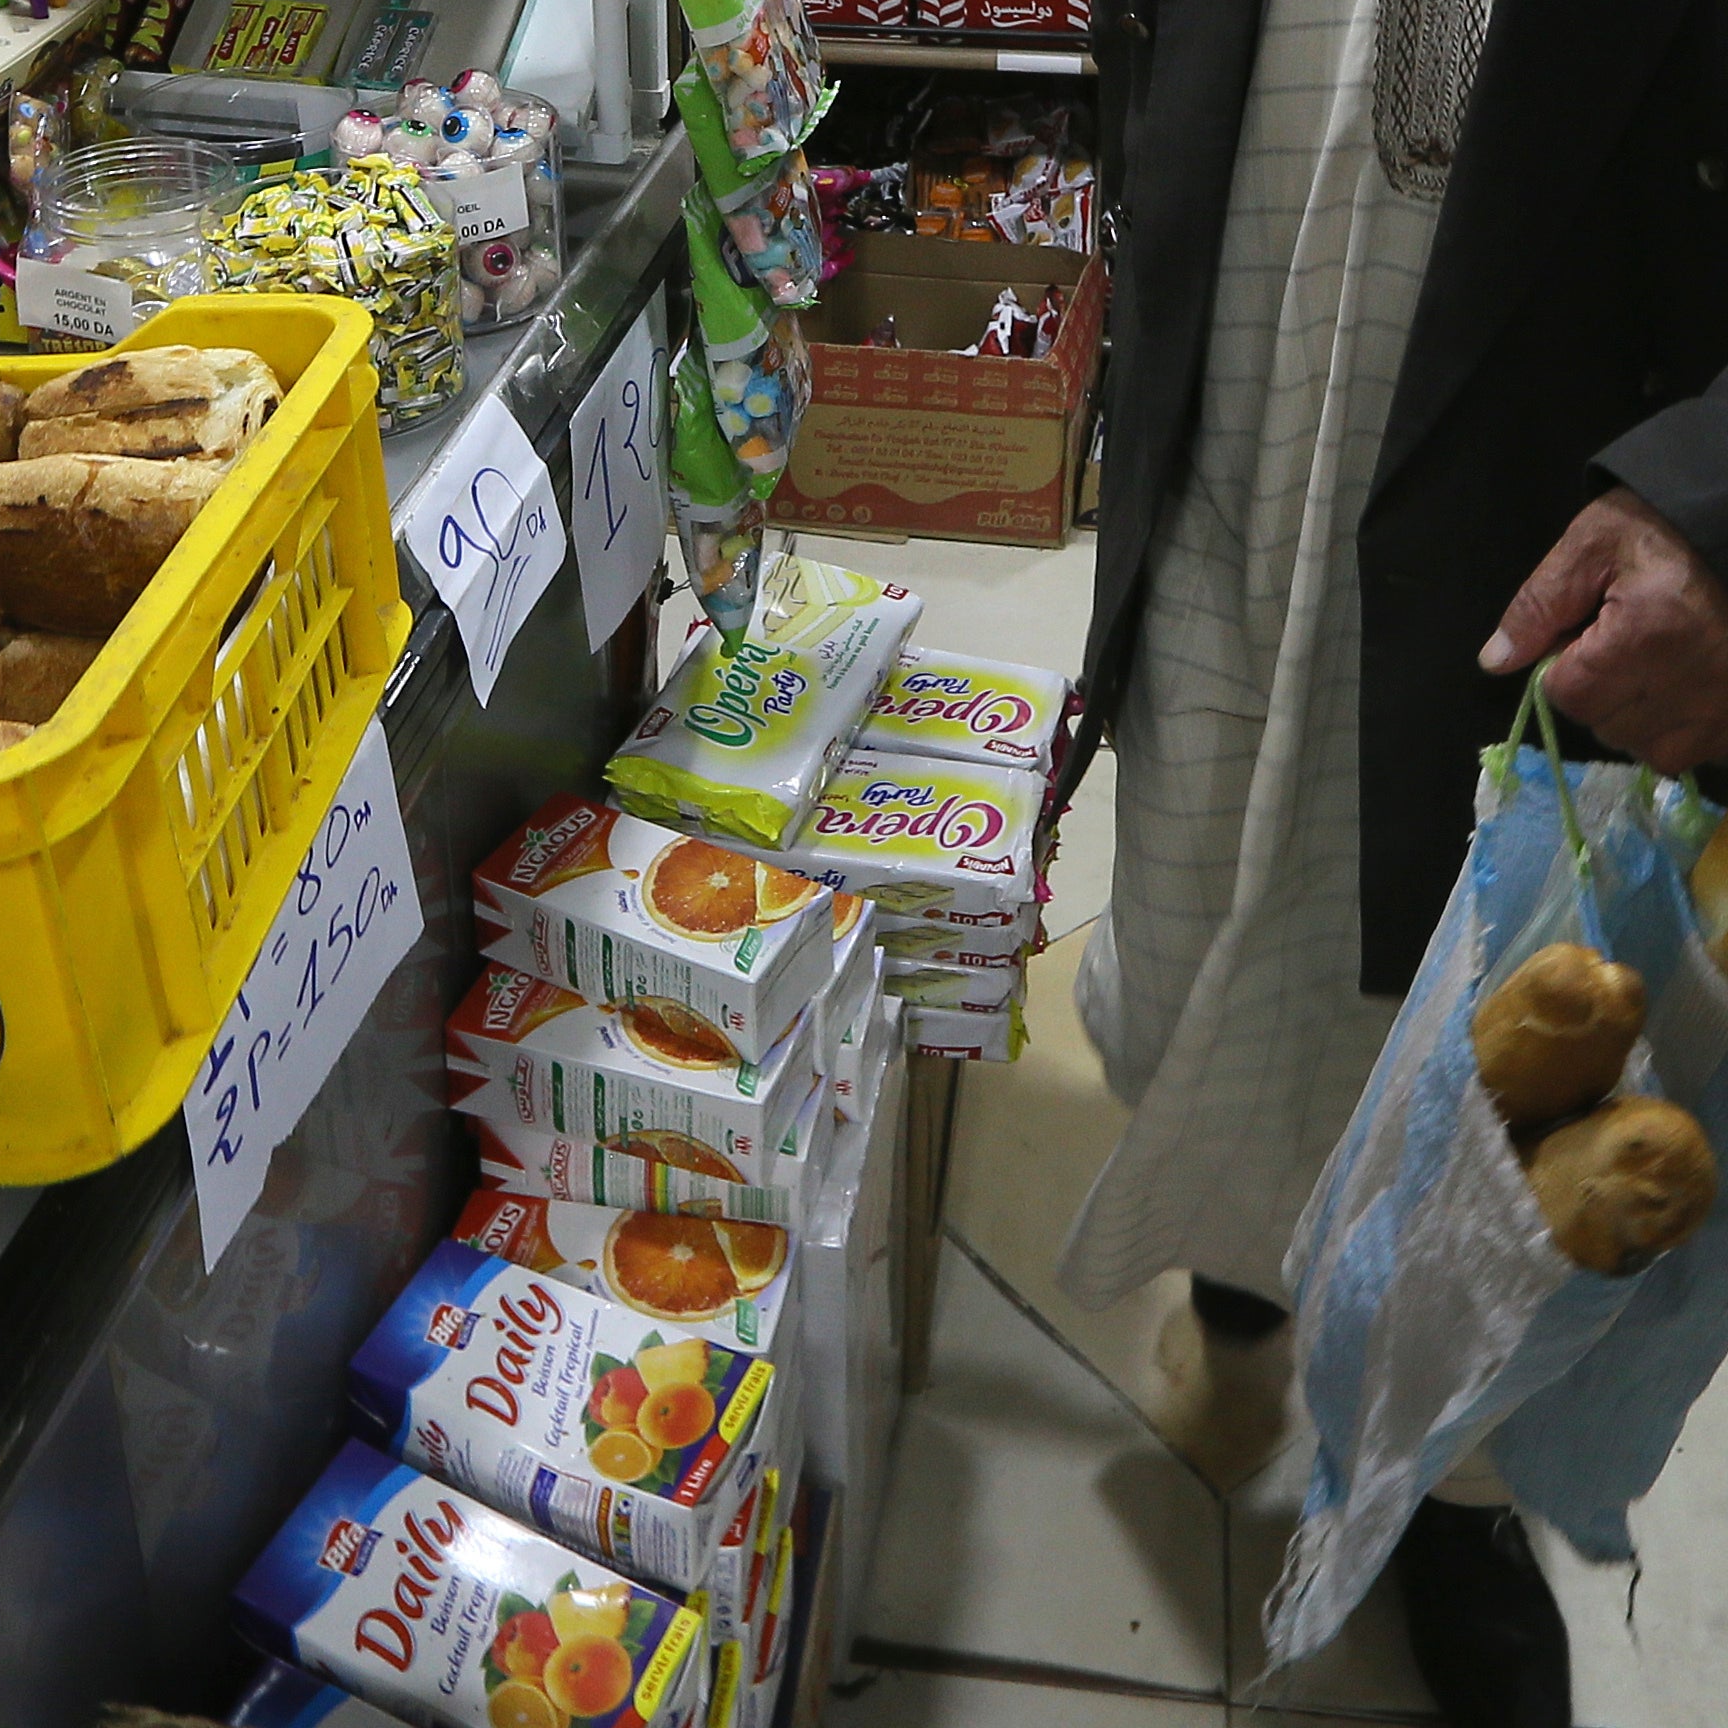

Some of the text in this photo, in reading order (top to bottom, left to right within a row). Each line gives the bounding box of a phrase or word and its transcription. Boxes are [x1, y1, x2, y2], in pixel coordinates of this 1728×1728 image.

[357, 22, 389, 71] CAPRICE
[390, 25, 420, 74] CAPRICE
[483, 219, 506, 236] DA
[52, 312, 115, 338] 15,00 DA
[53, 288, 107, 308] ARGENT EN
[55, 298, 108, 317] CHOCOLAT
[586, 347, 669, 552] 120
[438, 466, 525, 612] 90
[683, 639, 783, 749] Opéra
[764, 664, 809, 716] Party
[901, 672, 971, 695] Party
[815, 793, 1006, 851] Opéra
[861, 780, 935, 808] Party
[510, 808, 597, 883] NGAOUS
[483, 972, 534, 1030] NGAO
[465, 1282, 564, 1427] Daily
[531, 1343, 557, 1398] Boisson
[543, 1321, 584, 1449] Cocktail Tropical
[723, 1363, 766, 1431] servir frais
[686, 1458, 714, 1493] Litre
[355, 1498, 466, 1673] Daily
[431, 1576, 461, 1636] Boisson
[438, 1630, 470, 1698] Cocktail
[641, 1616, 692, 1705] servir frais
